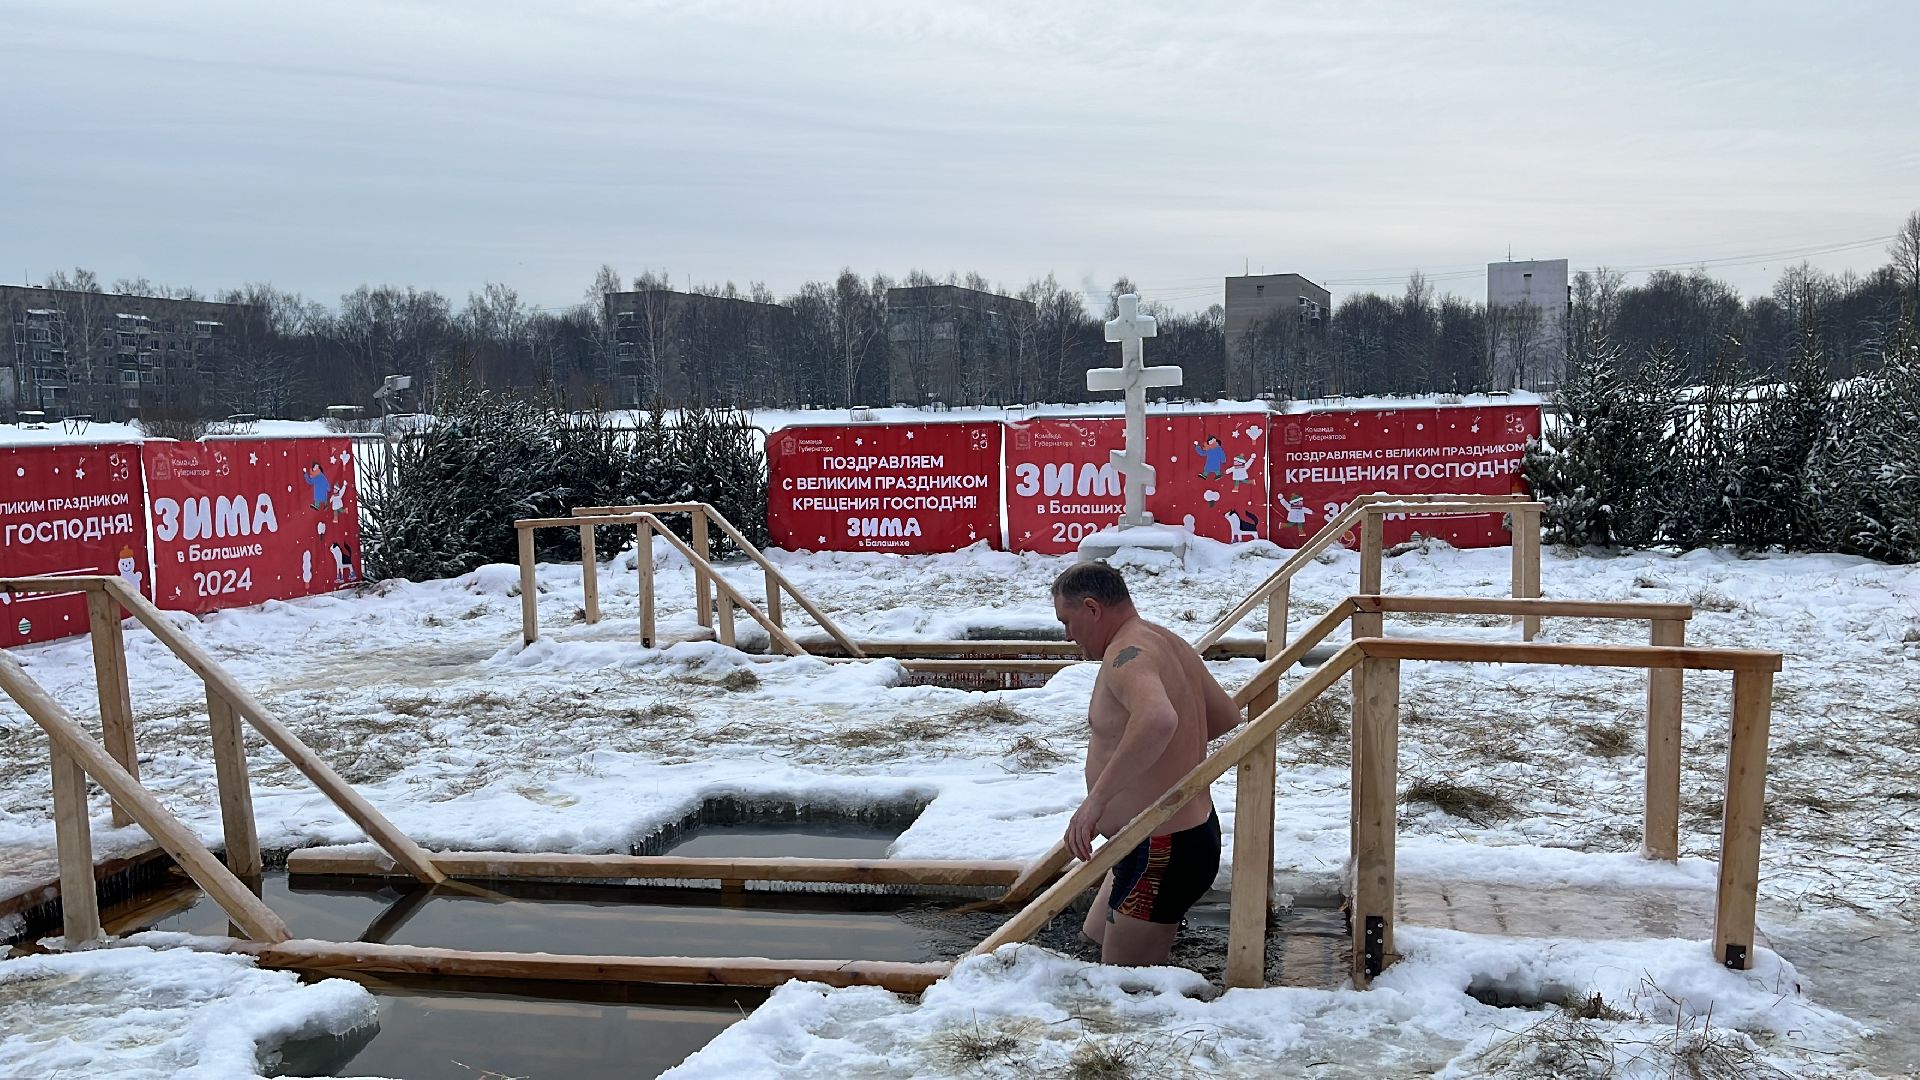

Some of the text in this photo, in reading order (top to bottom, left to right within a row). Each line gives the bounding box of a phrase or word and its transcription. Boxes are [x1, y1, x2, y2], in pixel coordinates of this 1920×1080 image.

[1305, 426, 1334, 434] Команда
[1305, 434, 1347, 442] Губернатора
[1286, 443, 1525, 462] ПОЗДРАВЛЯЕМ С ВЕЛИКИМ ПРАЗДНИКОМ
[823, 456, 944, 470] ПОЗДРАВЛЯЕМ
[783, 475, 988, 491] С ВЕЛИКИМ ПРАЗДНИКОМ
[1015, 462, 1156, 497] ЗИМ
[1285, 464, 1399, 484] КРЕЩЕНИЯ
[0, 493, 129, 515] ЛИКИМ ПРАЗДНИКОМ
[793, 496, 977, 512] КРЕЩЕНИЯ ГОСПОДНЯ!
[1037, 504, 1045, 514] в
[155, 493, 278, 542] ЗИМА
[847, 517, 922, 537] ЗИМА
[5, 513, 133, 546] ГОСПОДНЯ!
[1052, 522, 1114, 543] 202
[865, 538, 910, 547] Балашихе
[177, 543, 263, 563] в Балашихе
[193, 568, 253, 597] 2024
